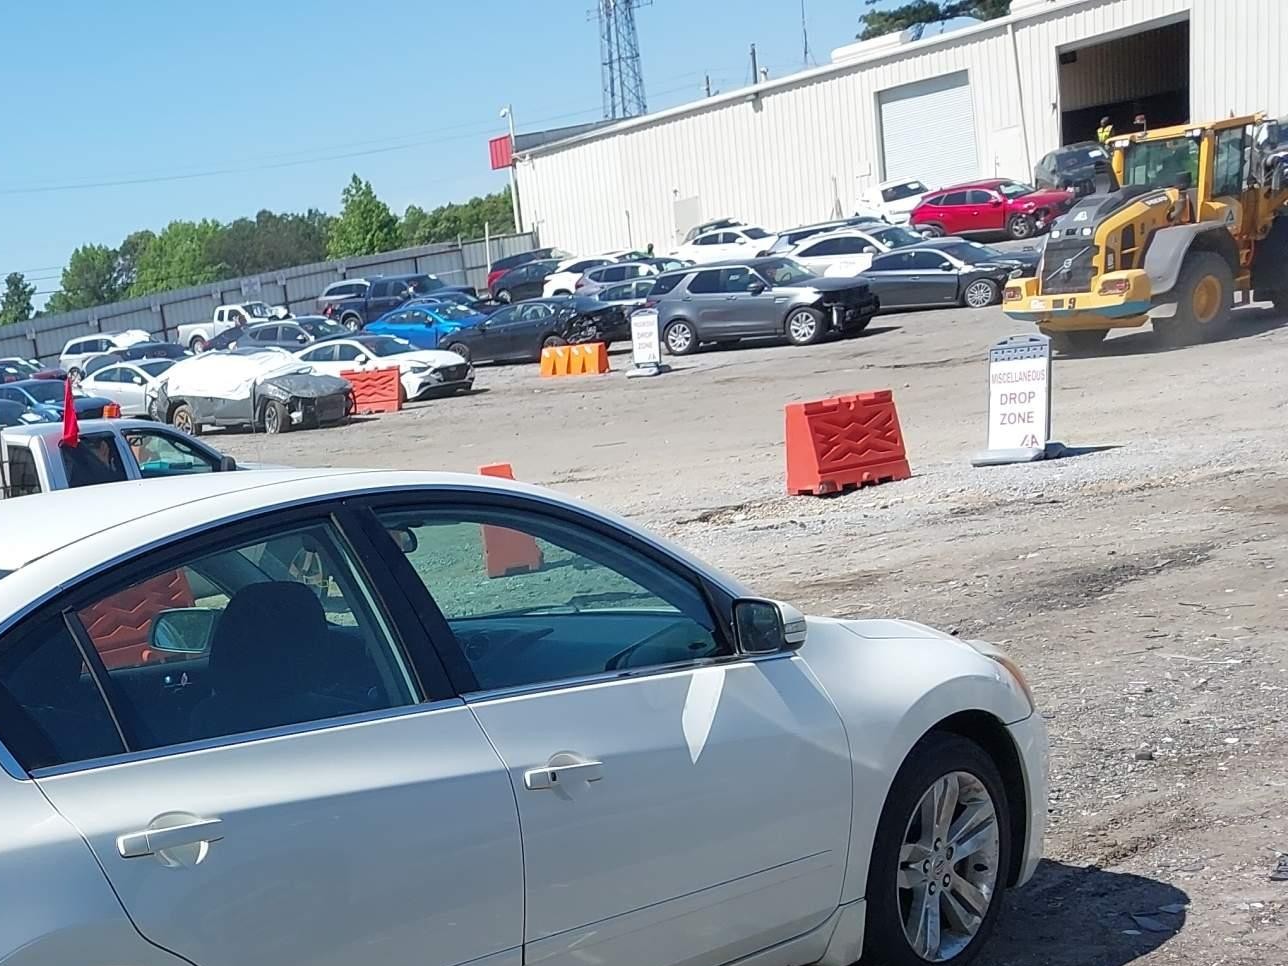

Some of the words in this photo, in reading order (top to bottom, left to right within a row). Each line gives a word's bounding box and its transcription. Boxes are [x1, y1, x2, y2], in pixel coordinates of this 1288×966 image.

[991, 368, 1046, 385] MISCELLANEOUS
[999, 391, 1036, 406] DROP
[999, 411, 1035, 425] ZONE
